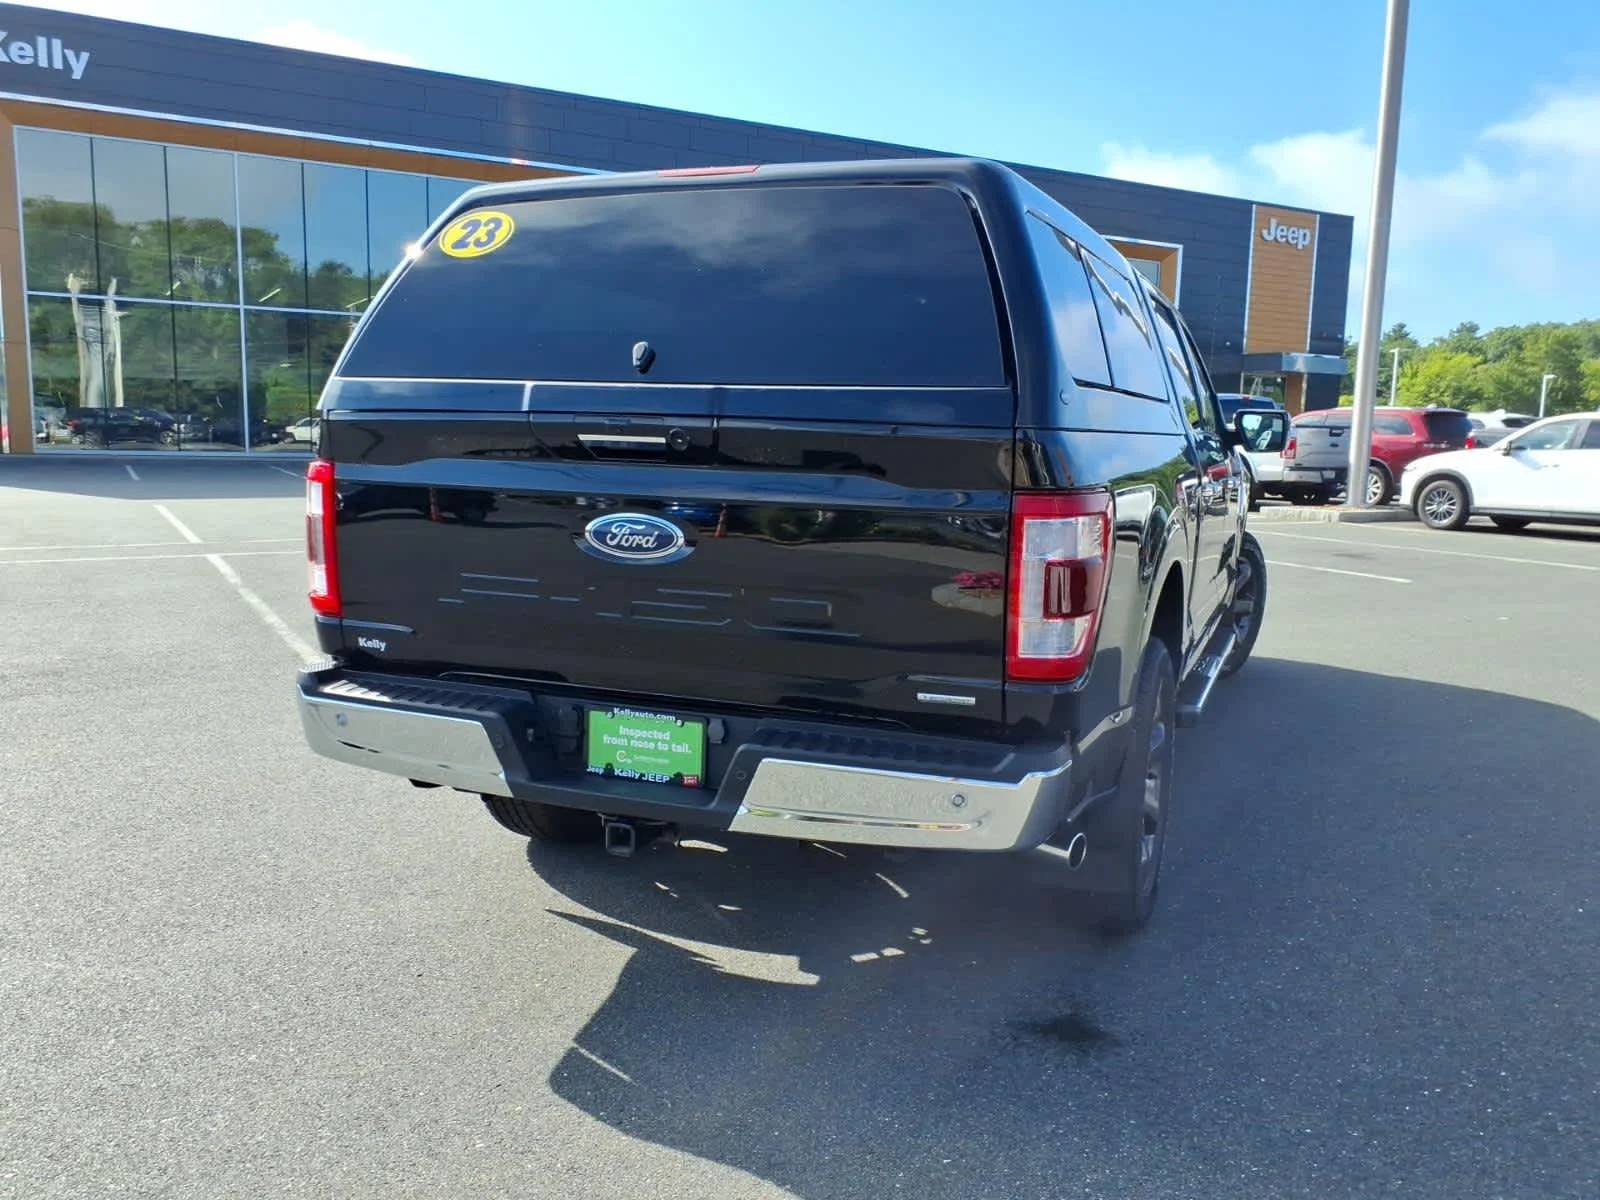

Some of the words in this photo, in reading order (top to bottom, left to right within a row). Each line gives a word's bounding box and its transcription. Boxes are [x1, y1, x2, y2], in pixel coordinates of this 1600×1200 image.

[451, 217, 503, 249] 23
[1262, 217, 1311, 249] Jeep
[606, 521, 659, 548] Ford
[358, 636, 386, 652] Kelly
[613, 707, 676, 721] Kellyauto.com
[619, 725, 671, 741] Inspected
[603, 733, 628, 746] from
[630, 740, 655, 750] nose
[657, 741, 669, 751] to
[671, 743, 692, 753] tail.
[614, 768, 640, 779] Kelly
[641, 773, 670, 784] JEEP
